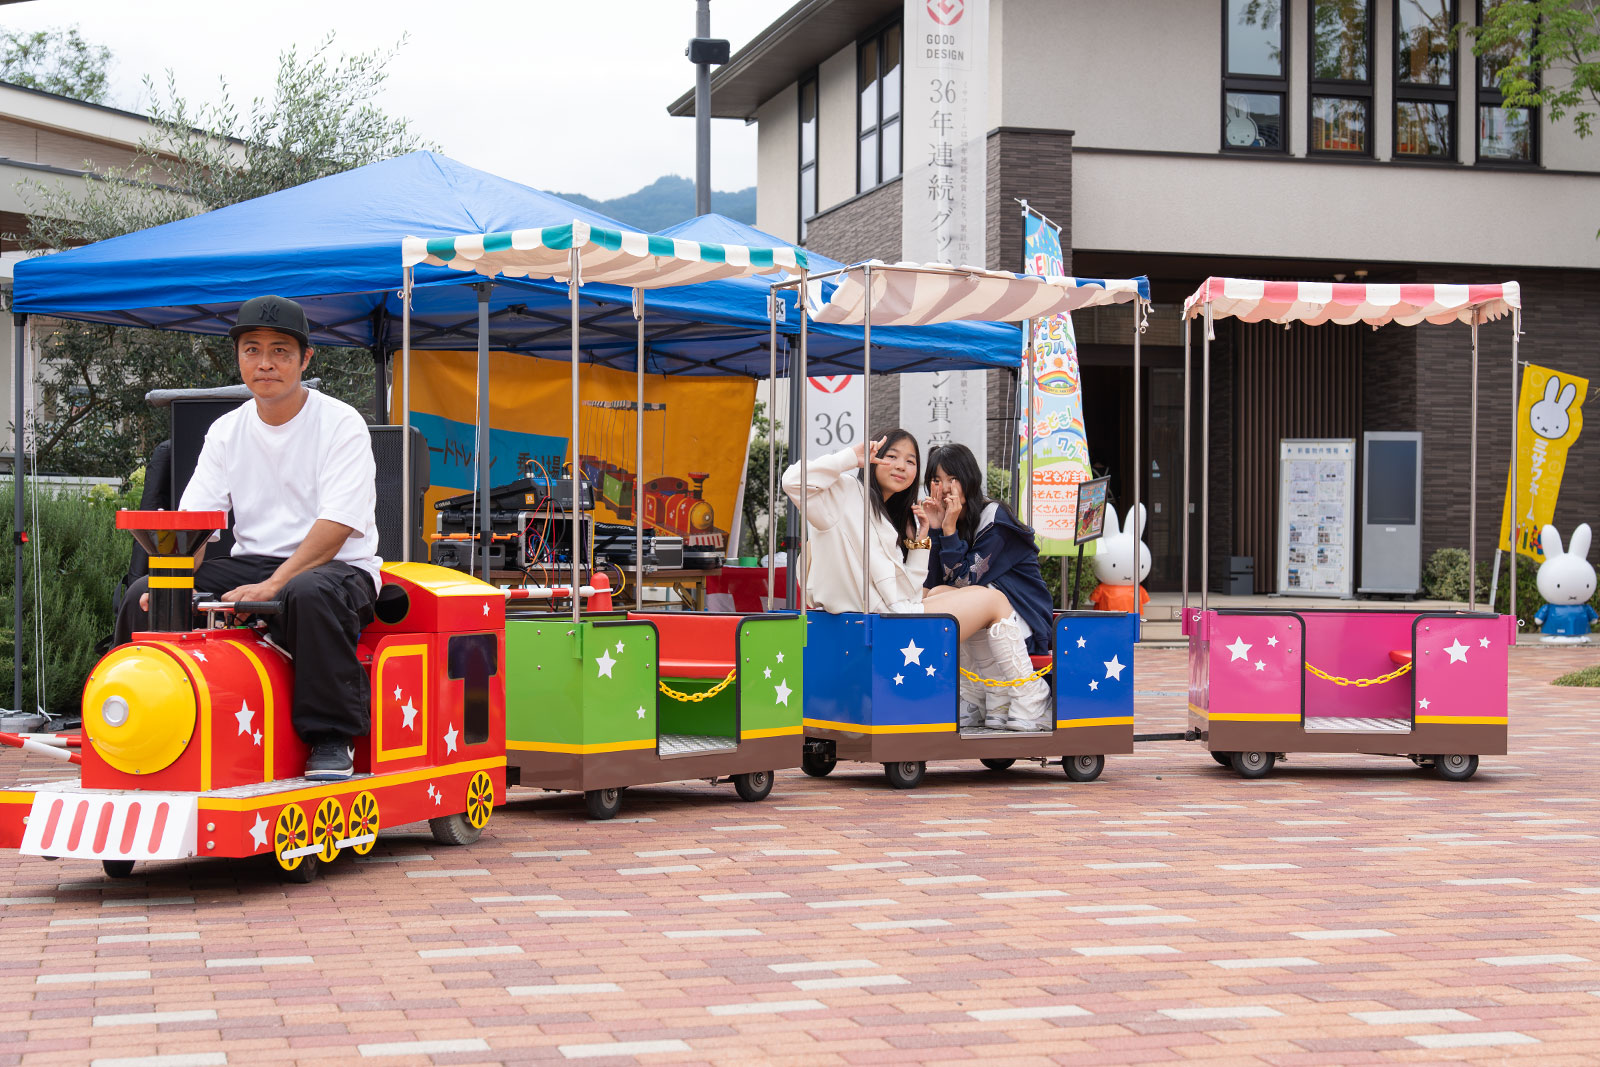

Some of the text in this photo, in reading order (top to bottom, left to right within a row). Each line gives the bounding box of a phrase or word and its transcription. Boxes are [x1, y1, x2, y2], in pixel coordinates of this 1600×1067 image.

[926, 34, 955, 45] GOOD
[926, 48, 964, 61] DESIGN
[927, 78, 956, 265] 36年連続グッ
[815, 410, 855, 447] 36
[1526, 437, 1549, 522] ミサワホーム
